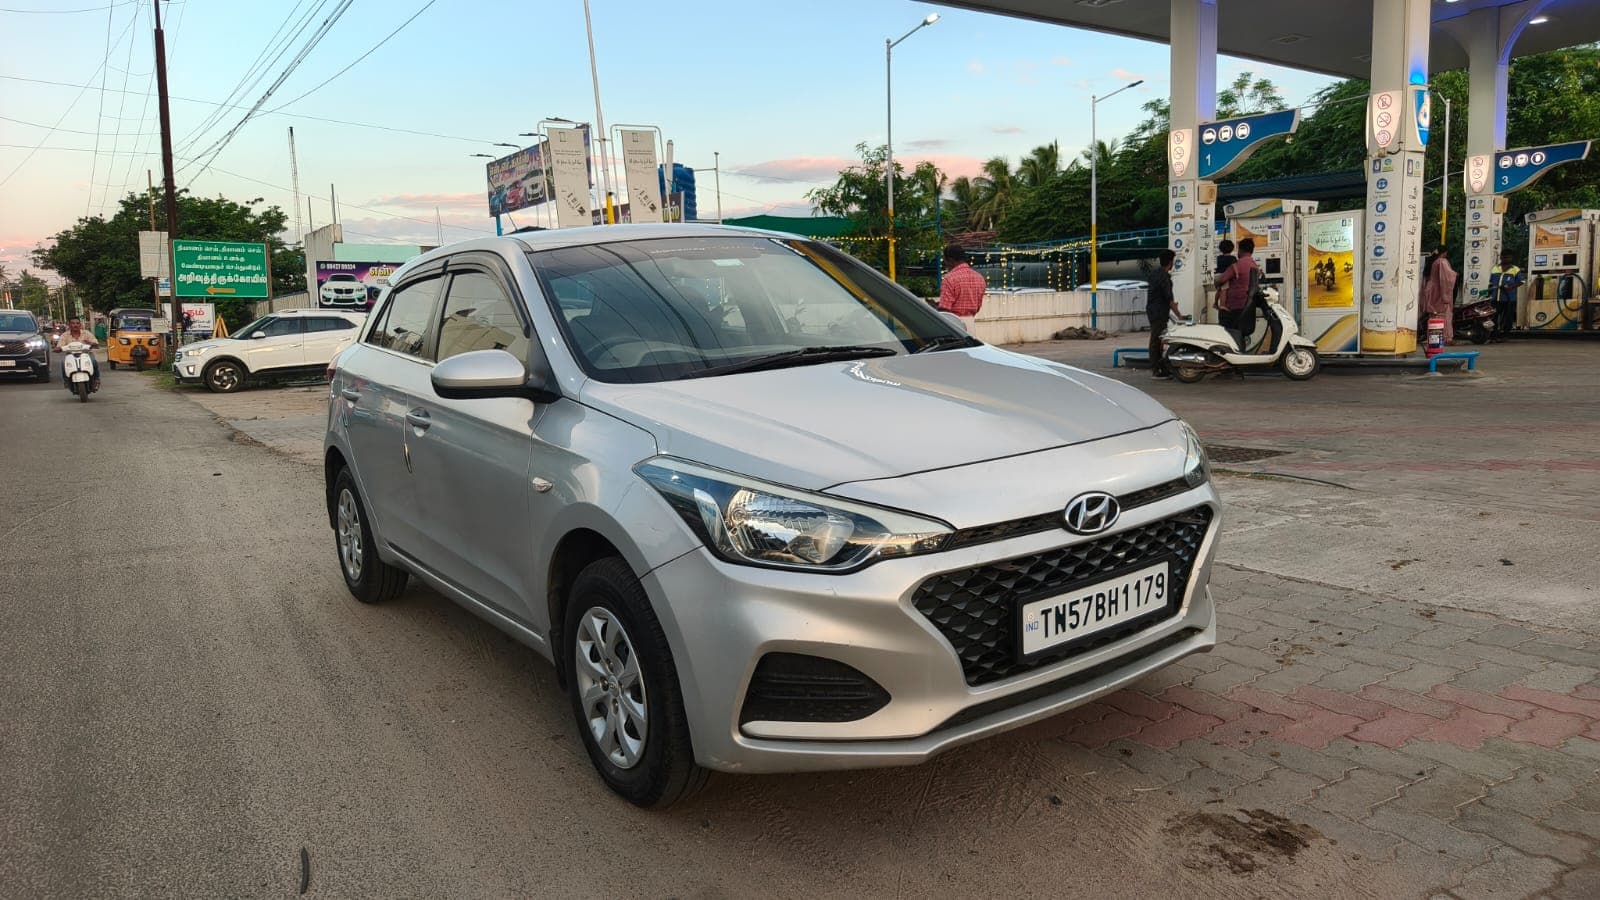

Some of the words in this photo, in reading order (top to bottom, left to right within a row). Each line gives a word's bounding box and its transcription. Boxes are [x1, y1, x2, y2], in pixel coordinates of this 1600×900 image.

[1205, 154, 1211, 166] 1
[1501, 176, 1509, 186] 3
[1041, 572, 1165, 638] TN57BH1179
[1025, 620, 1039, 632] IND
